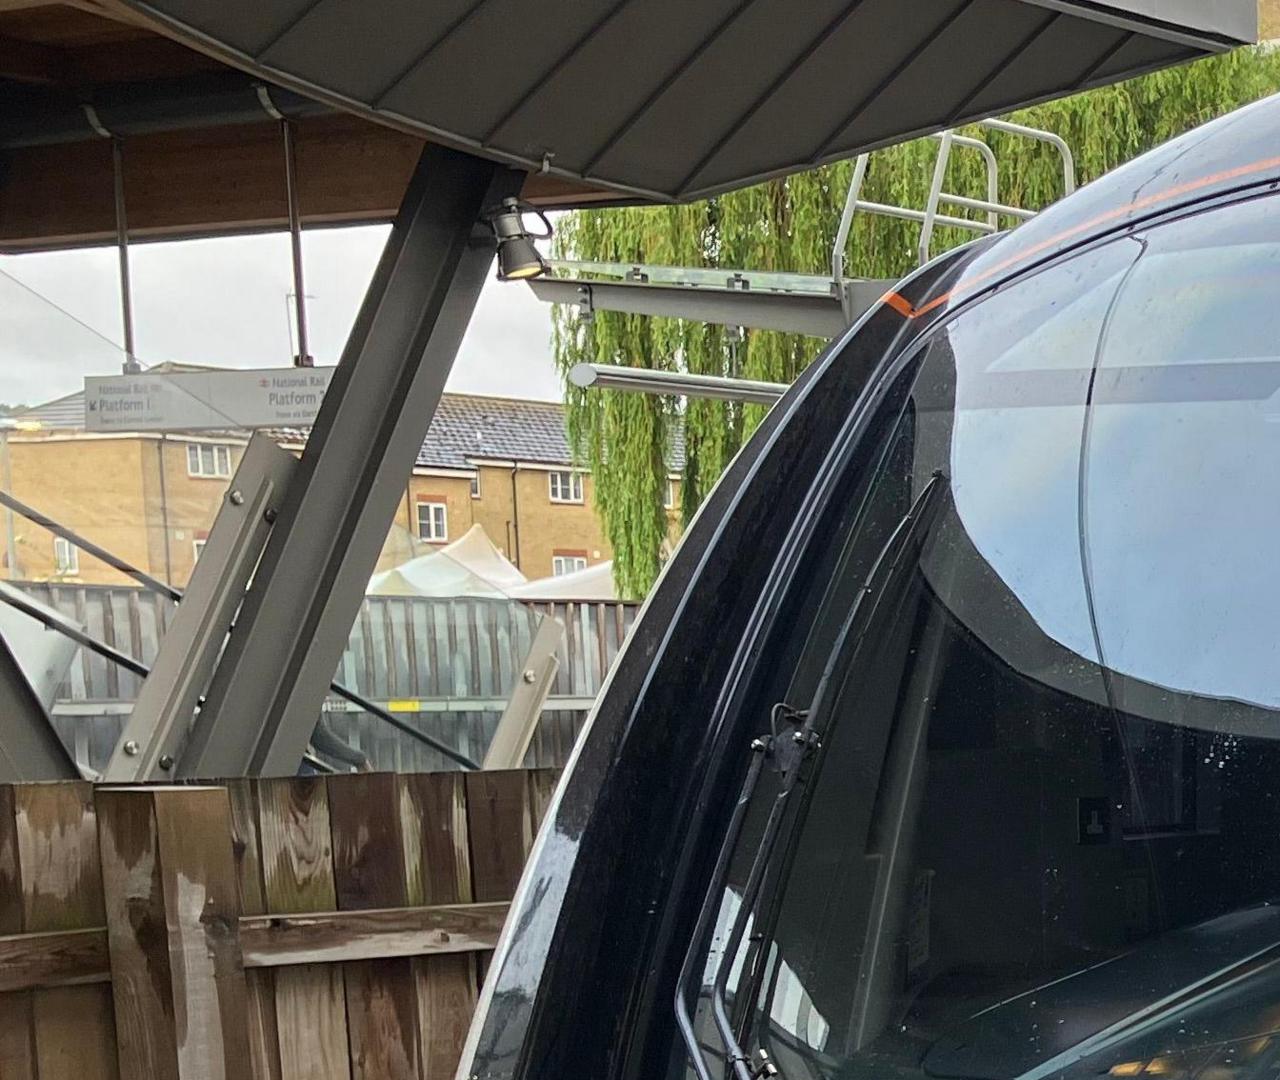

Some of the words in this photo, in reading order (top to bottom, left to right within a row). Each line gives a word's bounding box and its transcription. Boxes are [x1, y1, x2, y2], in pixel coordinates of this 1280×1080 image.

[272, 376, 307, 388] National
[310, 375, 326, 386] Rail
[99, 397, 144, 412] Platform
[269, 390, 317, 405] Platform
